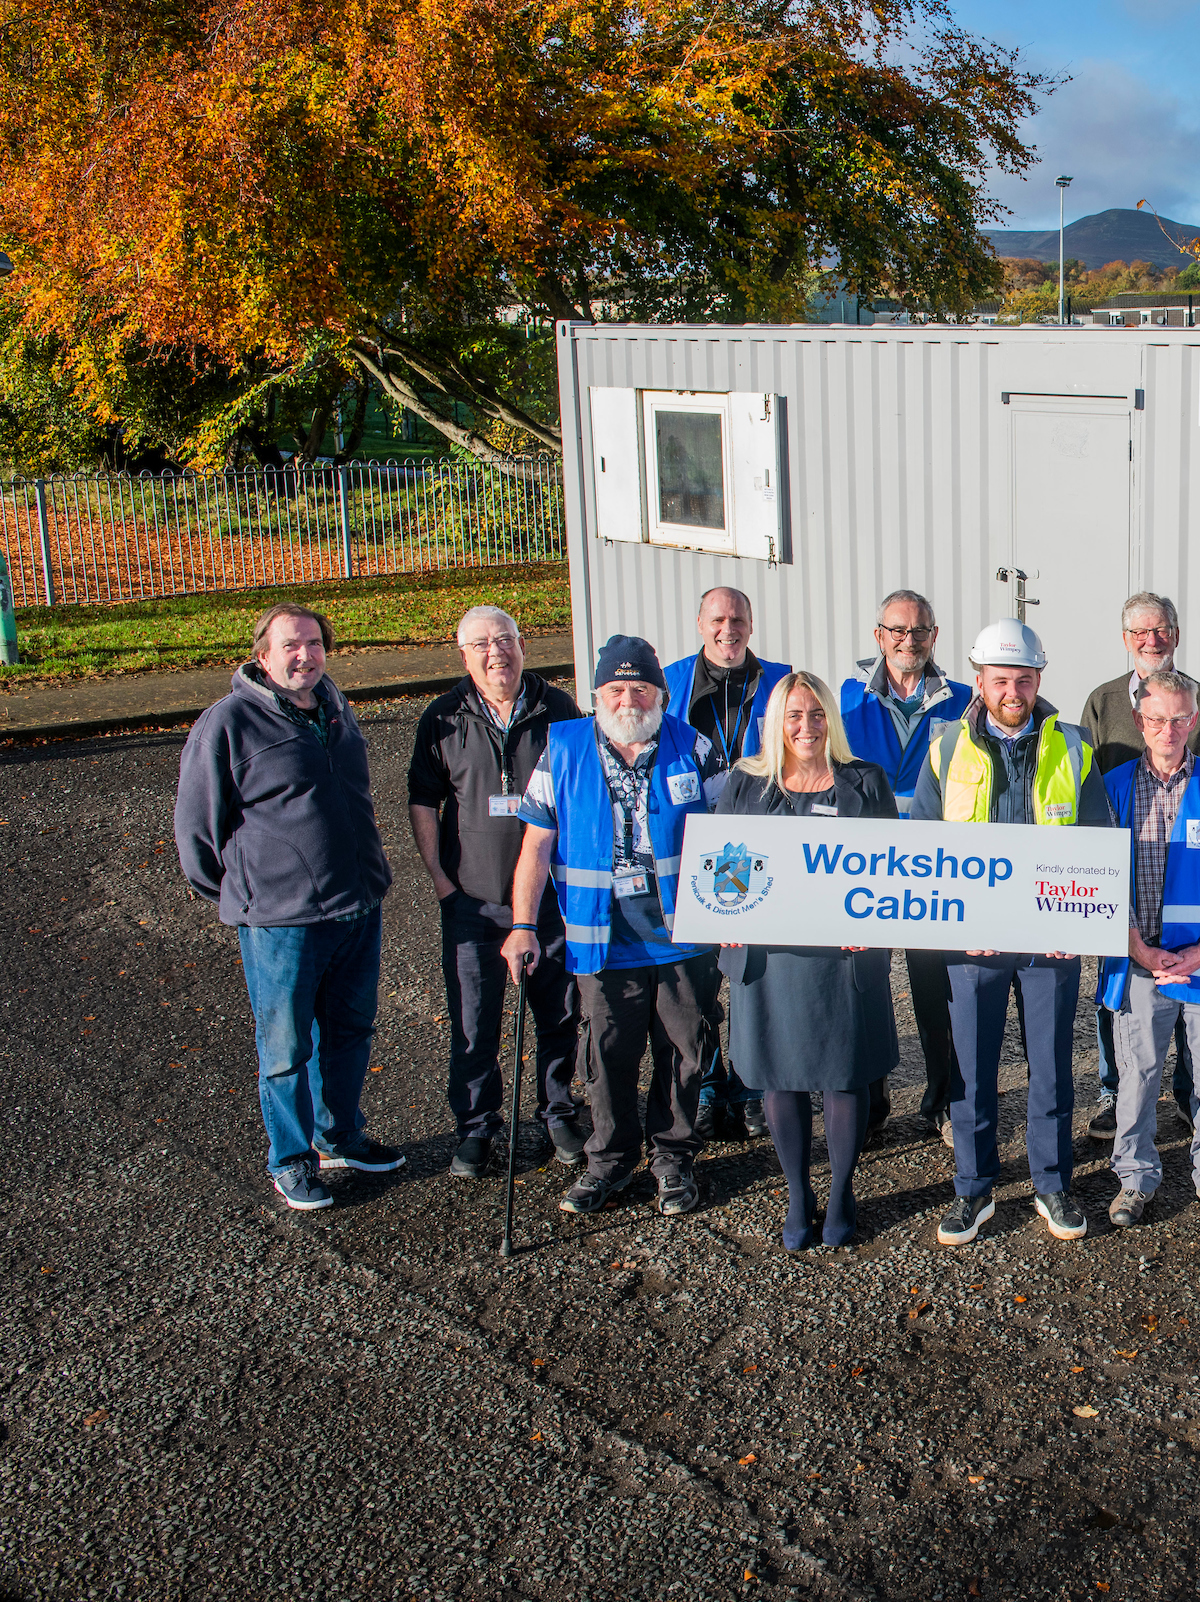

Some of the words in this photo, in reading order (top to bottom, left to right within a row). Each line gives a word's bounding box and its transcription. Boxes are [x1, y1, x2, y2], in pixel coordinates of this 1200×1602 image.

[1046, 804, 1065, 812] Taylor
[802, 843, 1013, 887] Workshop
[1036, 864, 1064, 875] Kindly
[1066, 865, 1105, 875] donated
[1108, 867, 1120, 877] by
[690, 875, 706, 905] Penicuik
[705, 902, 711, 910] &
[712, 906, 741, 915] District
[741, 896, 764, 913] Men's
[761, 876, 774, 897] Shed
[1035, 880, 1099, 901] Taylor
[843, 886, 965, 922] Cabin
[1035, 896, 1119, 919] Wimpey
